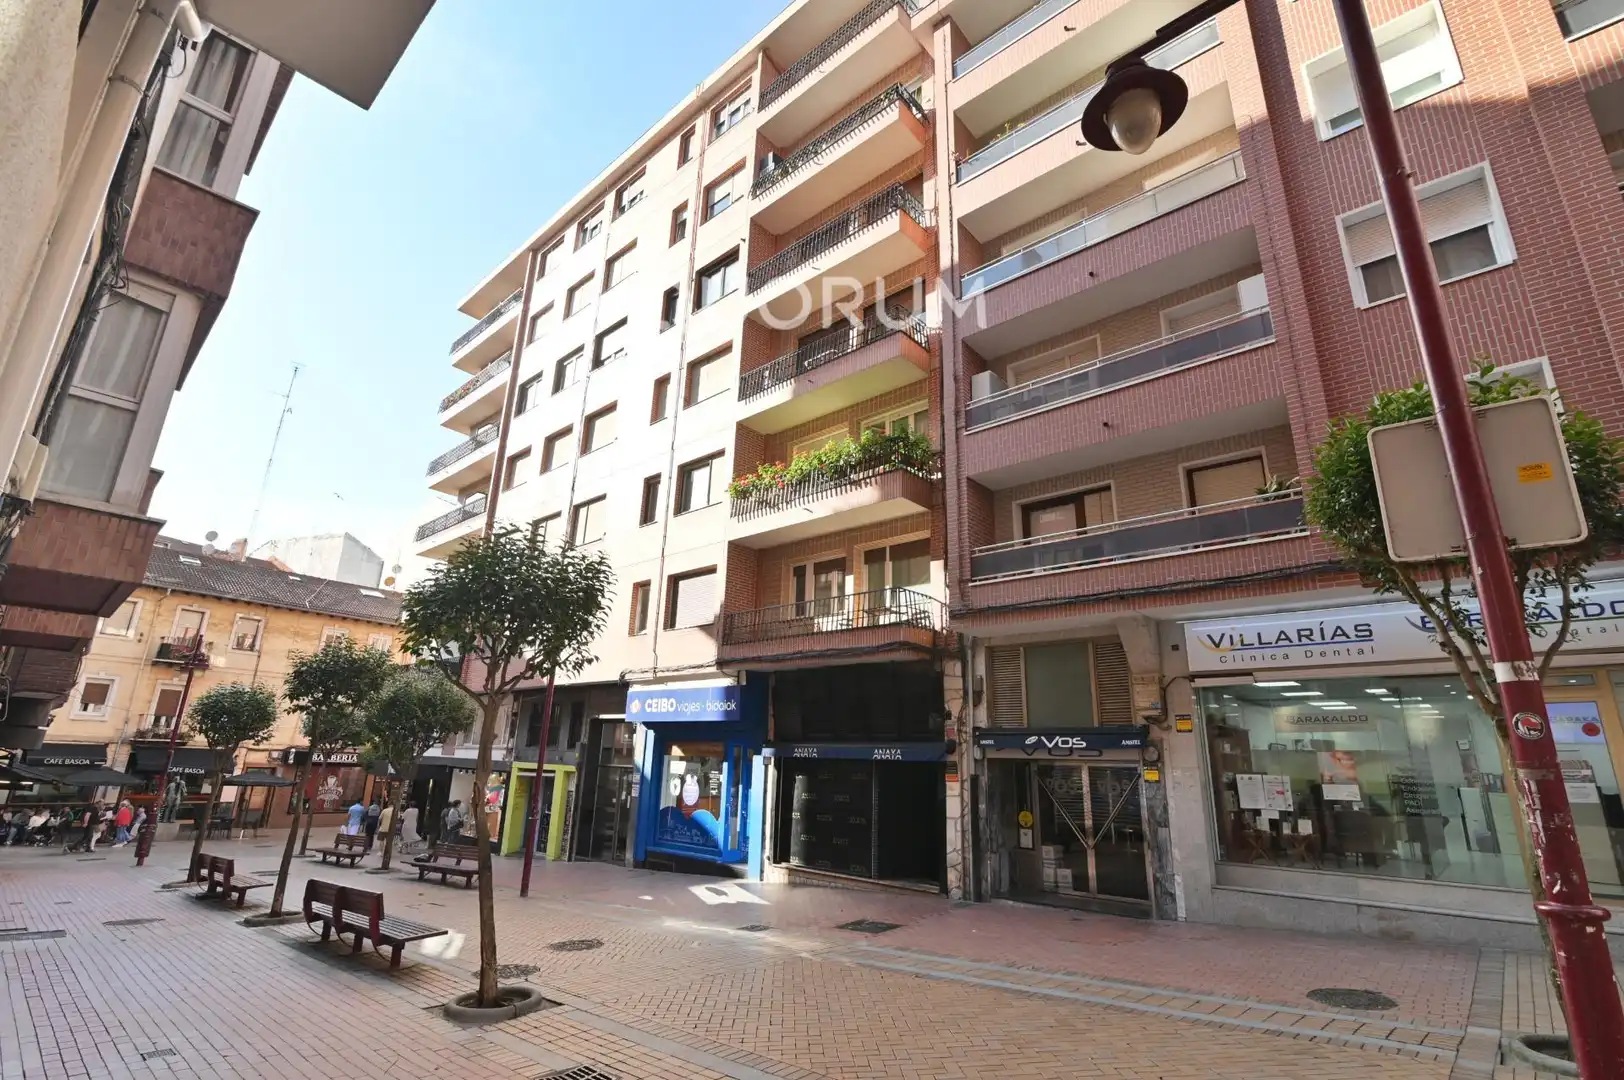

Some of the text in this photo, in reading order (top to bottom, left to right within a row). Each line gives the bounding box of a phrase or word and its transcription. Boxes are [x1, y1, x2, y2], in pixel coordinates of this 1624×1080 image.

[1206, 621, 1374, 649] VILLARÍAS
[1304, 646, 1375, 659] Dental
[644, 697, 737, 716] CEIBO viajes bidaiak
[1286, 714, 1369, 725] BARAKALDO
[1040, 735, 1087, 749] VOS
[312, 752, 359, 762] BABERIA
